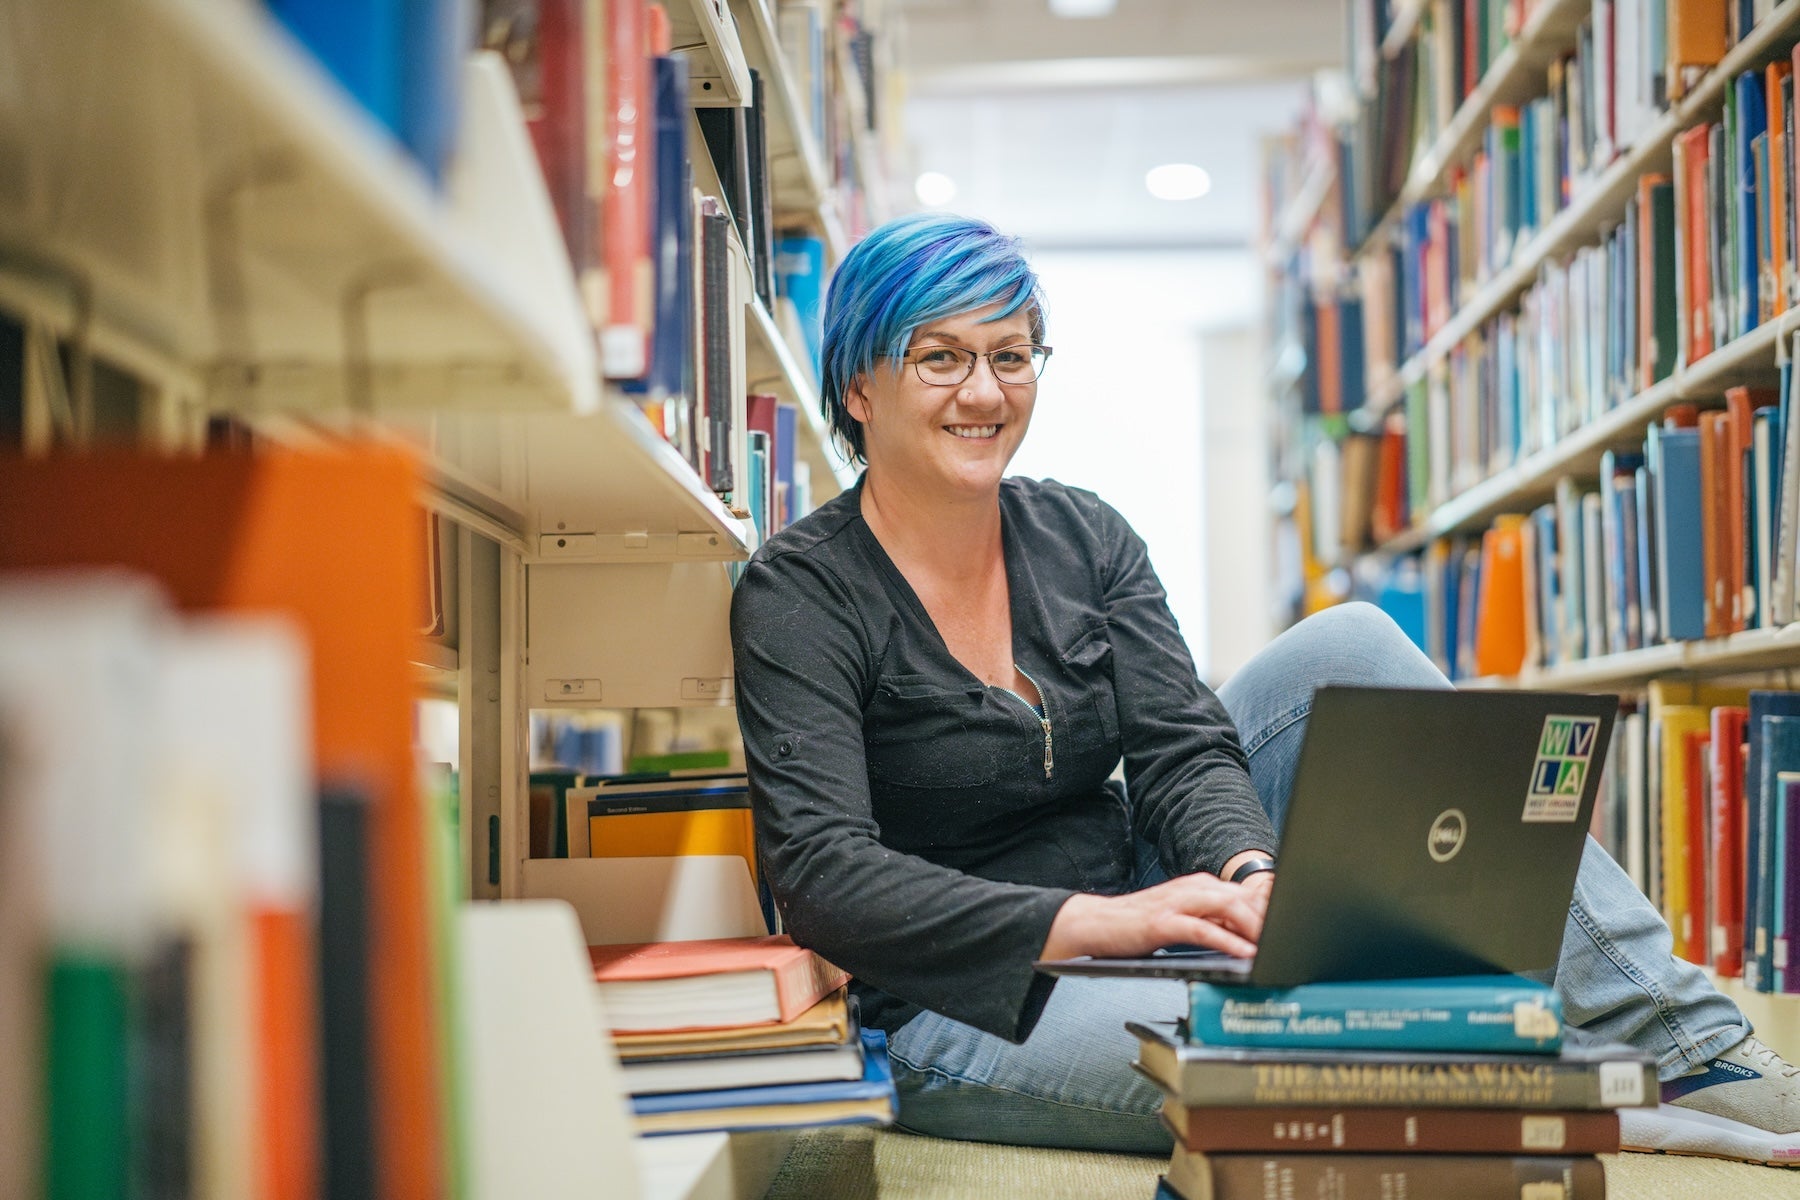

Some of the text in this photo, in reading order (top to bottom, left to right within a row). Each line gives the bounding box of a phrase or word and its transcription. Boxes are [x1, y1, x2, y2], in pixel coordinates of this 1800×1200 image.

[1222, 998, 1301, 1016] American
[1222, 1015, 1284, 1034] Women
[1253, 1064, 1313, 1086] THE
[1714, 1060, 1754, 1078] BROOKS
